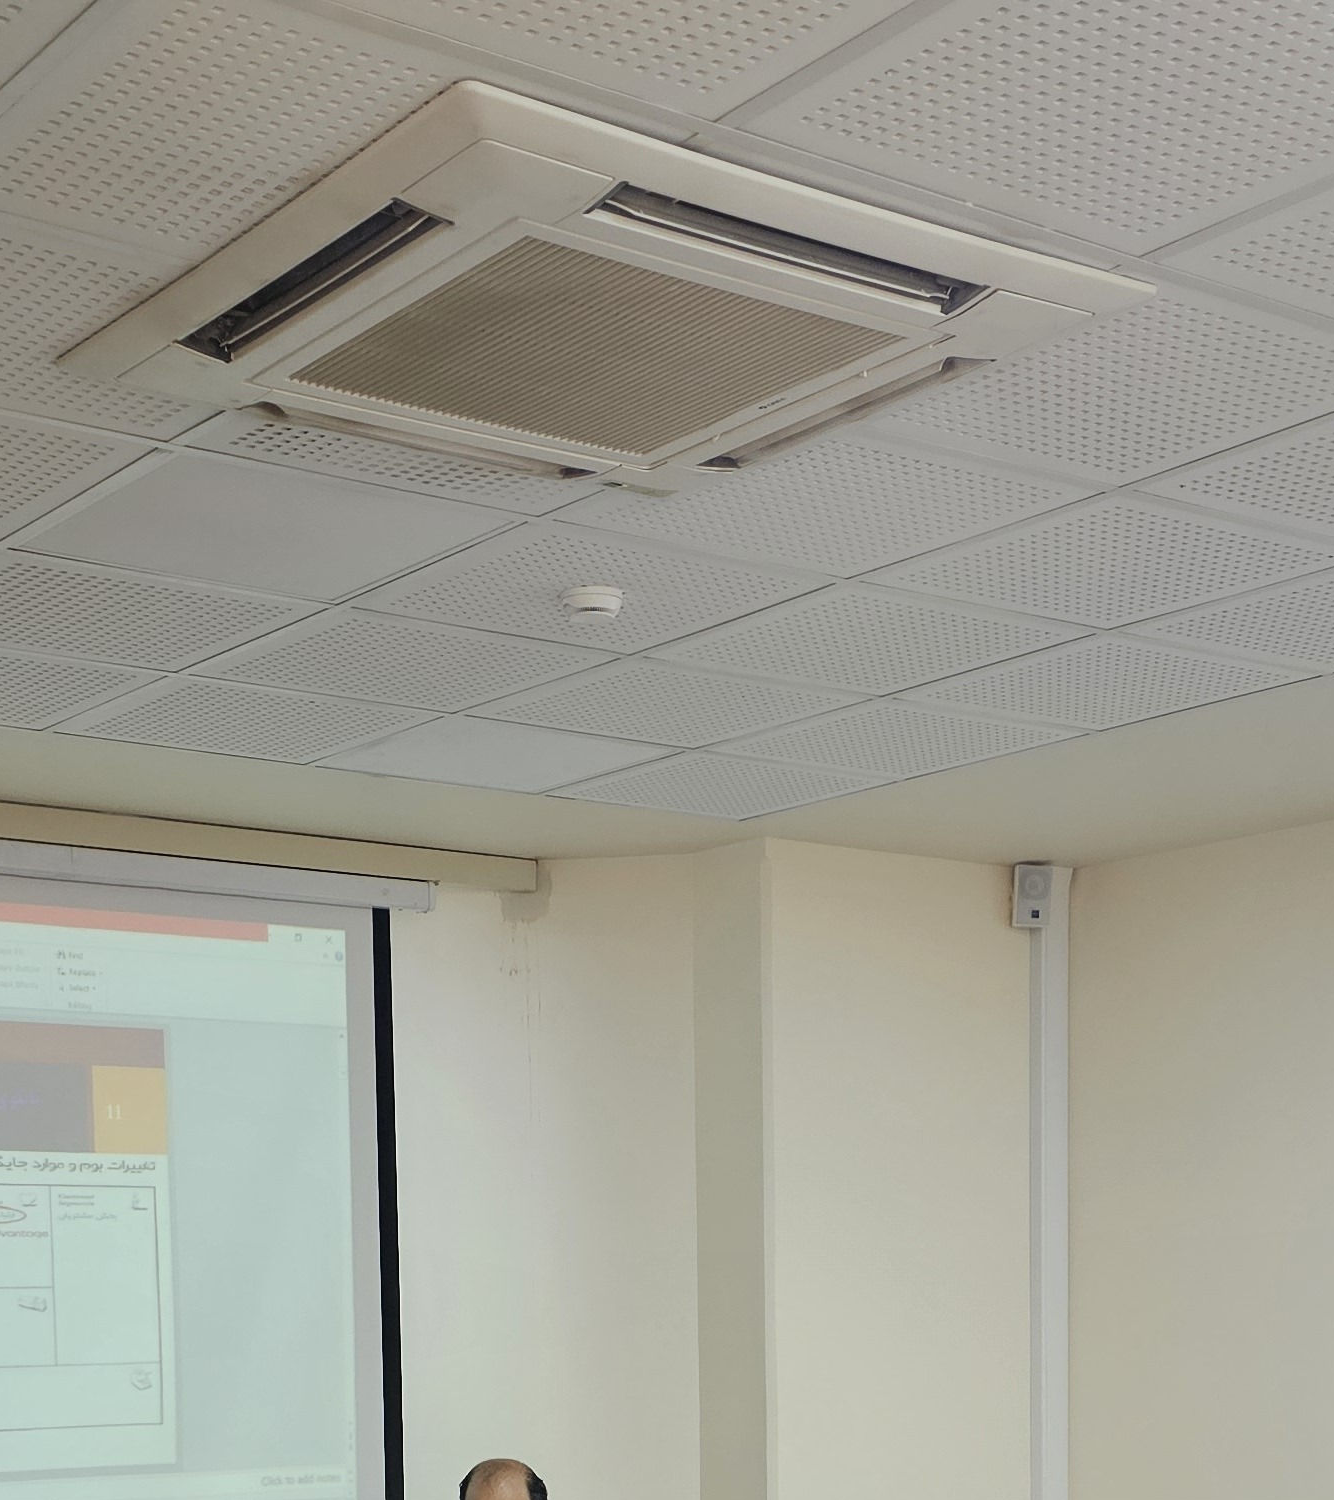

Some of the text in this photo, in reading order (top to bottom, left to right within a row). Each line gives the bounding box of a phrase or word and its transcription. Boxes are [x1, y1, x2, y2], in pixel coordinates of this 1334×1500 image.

[106, 1104, 122, 1121] 11
[32, 1158, 65, 1172] موارد
[68, 1162, 76, 1172] و
[80, 1161, 104, 1174] بوم
[107, 1159, 156, 1174] تغییرات
[261, 1476, 284, 1486] Click
[285, 1476, 295, 1484] to
[298, 1474, 314, 1484] add
